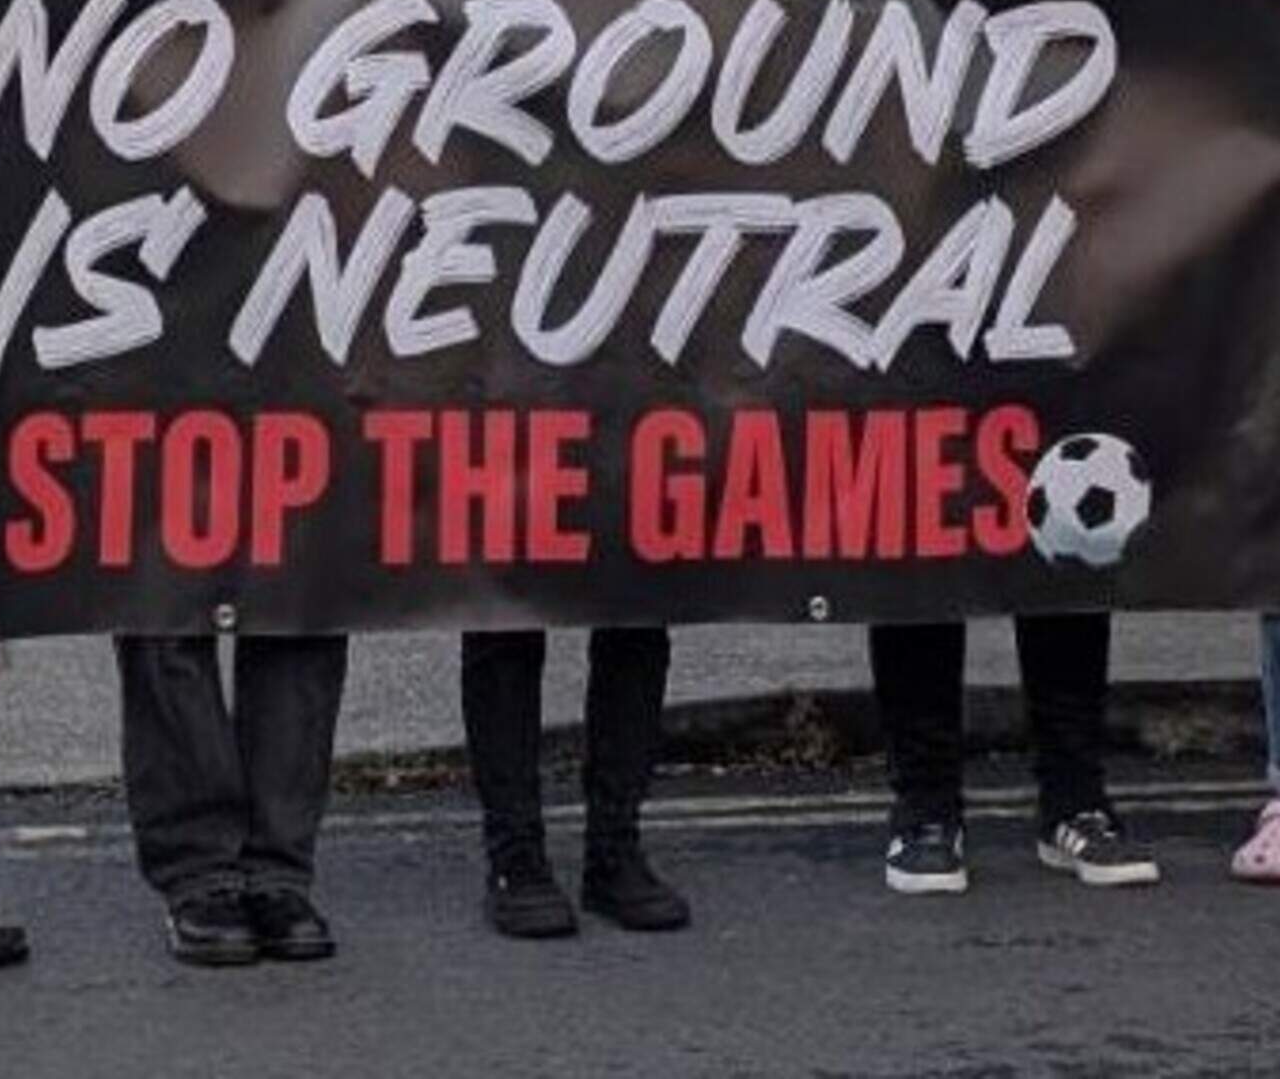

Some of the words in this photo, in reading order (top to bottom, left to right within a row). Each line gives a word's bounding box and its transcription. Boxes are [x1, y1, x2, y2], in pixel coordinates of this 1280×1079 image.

[229, 186, 1076, 371] NEUTRAL
[5, 410, 329, 571] STOP
[364, 409, 591, 564] THE
[628, 404, 1039, 563] GAMES
